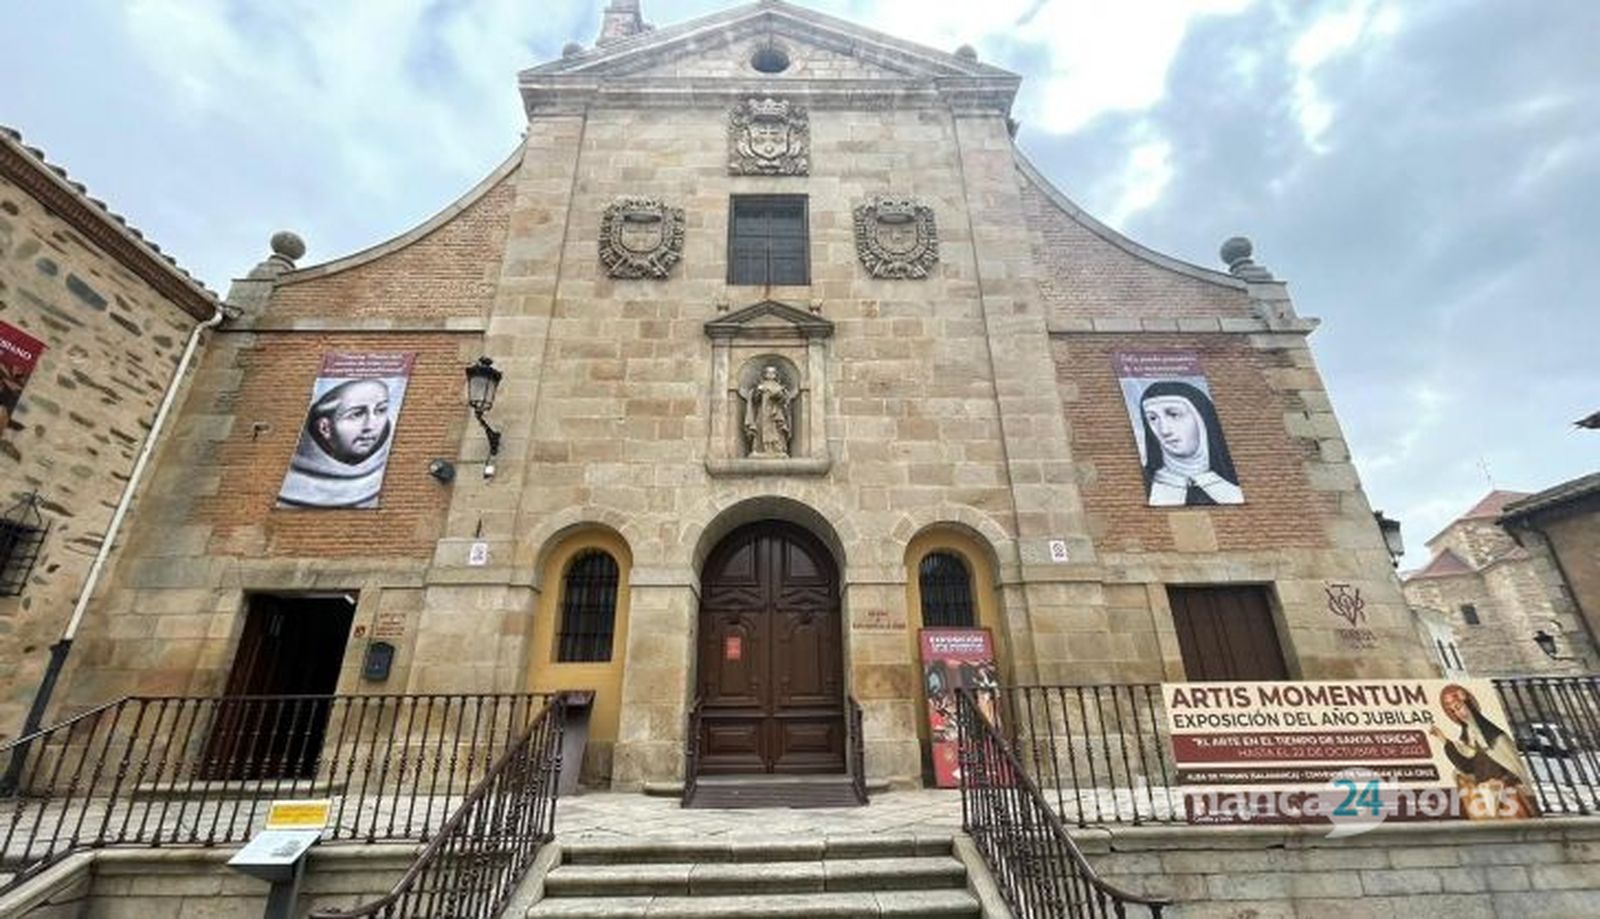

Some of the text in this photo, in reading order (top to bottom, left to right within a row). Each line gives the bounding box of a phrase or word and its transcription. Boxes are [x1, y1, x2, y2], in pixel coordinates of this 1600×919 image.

[1171, 684, 1428, 708] ARTIS MOMENTUM
[1173, 708, 1435, 728] EXPOSICIÓN DEL AÑO JUBILAR
